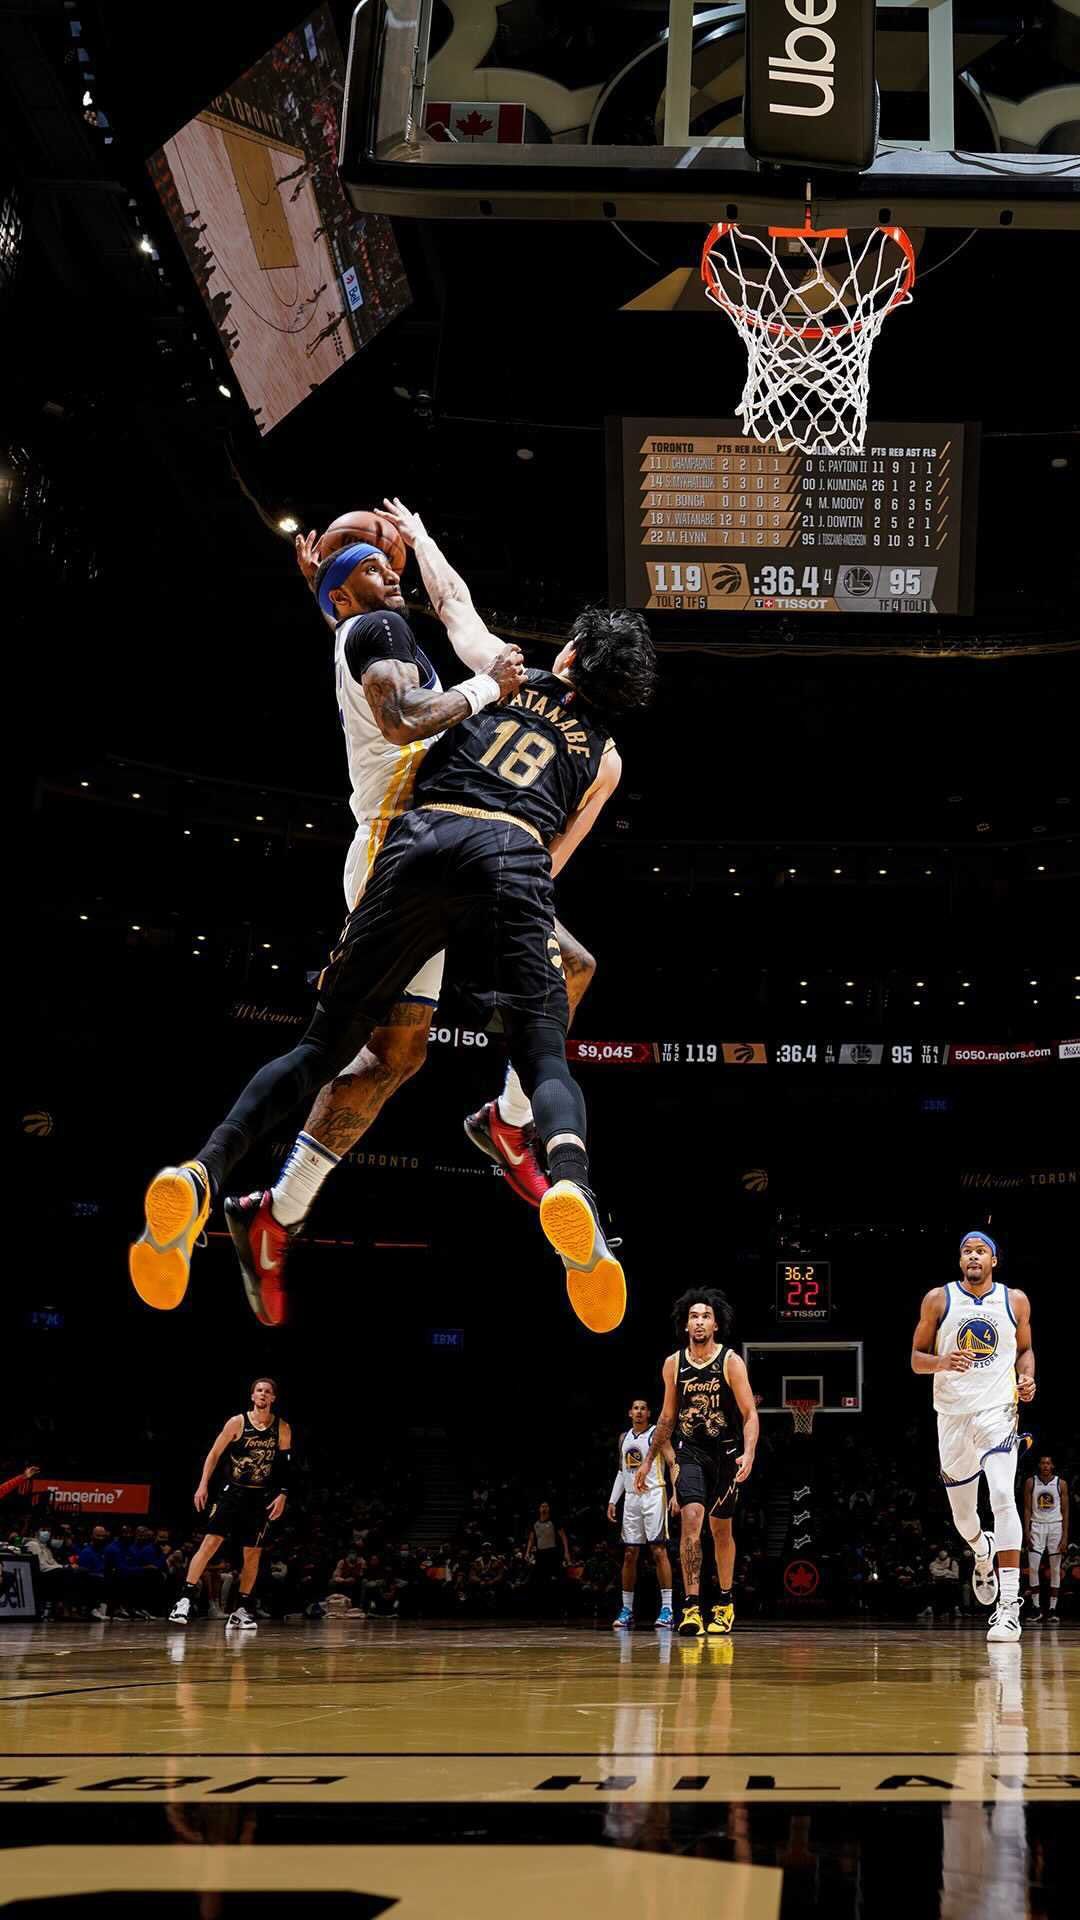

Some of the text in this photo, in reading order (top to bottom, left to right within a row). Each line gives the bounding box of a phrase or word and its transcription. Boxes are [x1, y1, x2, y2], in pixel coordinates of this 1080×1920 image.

[652, 442, 783, 455] TORONTO PTS REB AST FL
[872, 447, 886, 457] PTS
[889, 448, 904, 457] REB
[906, 448, 921, 457] AST
[923, 448, 937, 457] FLS
[650, 457, 661, 470] 11
[722, 458, 729, 470] 2
[740, 459, 747, 471] 2
[758, 460, 763, 471] 1
[774, 460, 780, 472] 1
[806, 460, 813, 472] 0
[828, 460, 858, 473] PAYTON
[873, 461, 885, 473] 11
[892, 461, 900, 473] 9
[910, 461, 916, 474] 1
[927, 462, 933, 474] 1
[650, 475, 663, 488] 14
[722, 476, 729, 489] 5
[740, 477, 747, 489] 3
[757, 477, 764, 489] 0
[773, 478, 781, 490] 2
[803, 478, 933, 492] 00 J. KUMINGA 26 1 2 2
[650, 494, 662, 506] 17
[675, 494, 705, 508] BONGA
[722, 495, 729, 507] 0
[740, 495, 747, 508] 0
[757, 496, 764, 508] 0
[773, 496, 781, 508] 2
[806, 497, 932, 511] 4 M. MOODY 8 6 3 5
[650, 512, 664, 525] 18
[675, 513, 716, 526] WATANABE
[720, 514, 733, 526] 12
[740, 514, 747, 526] 4
[757, 514, 764, 526] 0
[773, 515, 781, 527] 3
[803, 515, 931, 529] 21 J. DOWTIN 2 5 2 1
[650, 530, 663, 543] 22
[680, 531, 707, 543] FLYNN
[723, 531, 729, 544] 7
[741, 532, 747, 544] 1
[757, 533, 764, 544] 2
[773, 533, 781, 545] 3
[802, 533, 815, 545] 95
[873, 535, 880, 547] 9
[888, 535, 900, 547] 10
[908, 535, 915, 547] 3
[924, 535, 931, 547] 1
[655, 565, 921, 596] 119 :36.4 4 95
[656, 596, 707, 609] TOL 2 TF 5
[775, 599, 828, 609] TISSOT
[880, 600, 928, 612] TF 4 TOL 1
[510, 688, 590, 758] ATANABE
[477, 719, 557, 788] 18
[577, 1043, 633, 1061] $9,045
[686, 1044, 717, 1062] 119
[776, 1044, 817, 1062] :36.4
[891, 1045, 913, 1063] 95
[955, 1047, 1051, 1062] 5050.raptors.com
[347, 1151, 420, 1169] TORONTO
[784, 1266, 814, 1280] 36.2
[786, 1281, 819, 1305] 22
[793, 1310, 828, 1318] TISSOT
[983, 1329, 993, 1342] 4
[679, 1377, 721, 1395] Toronto
[710, 1394, 720, 1408] 11
[47, 1486, 115, 1507] Tangerine
